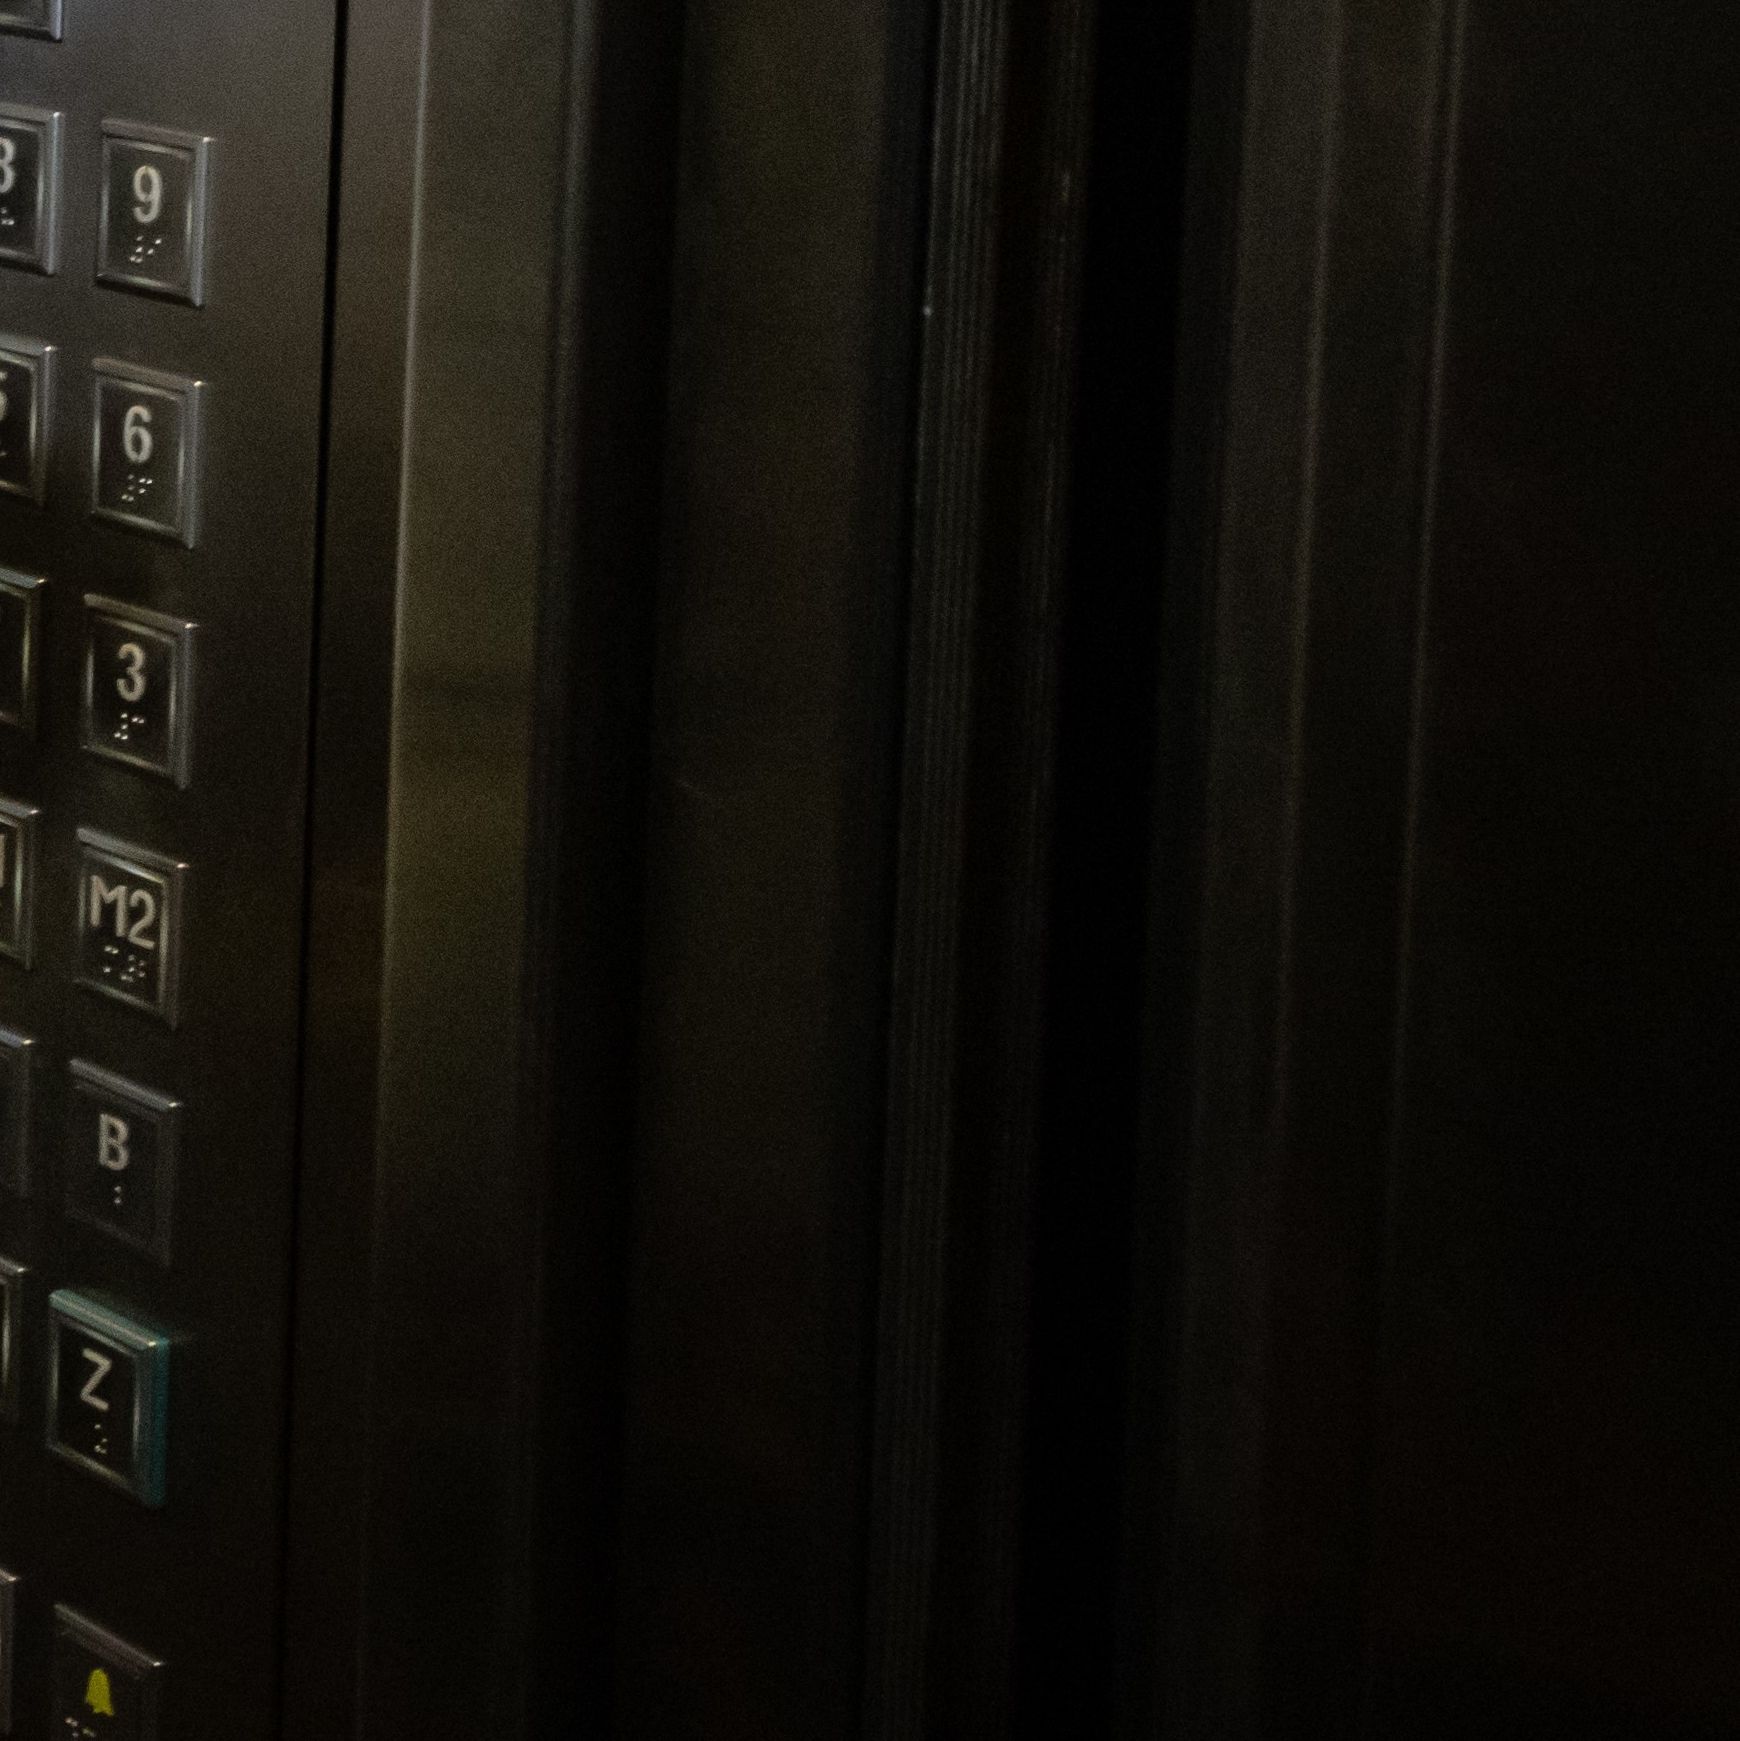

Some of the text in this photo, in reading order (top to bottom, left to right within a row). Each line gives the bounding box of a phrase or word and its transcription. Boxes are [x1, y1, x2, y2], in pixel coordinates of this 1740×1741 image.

[132, 165, 162, 223] 9
[123, 405, 153, 463] 6
[117, 643, 146, 702] 3
[91, 875, 154, 949] M2
[99, 1113, 129, 1171] B
[80, 1347, 111, 1410] Z
